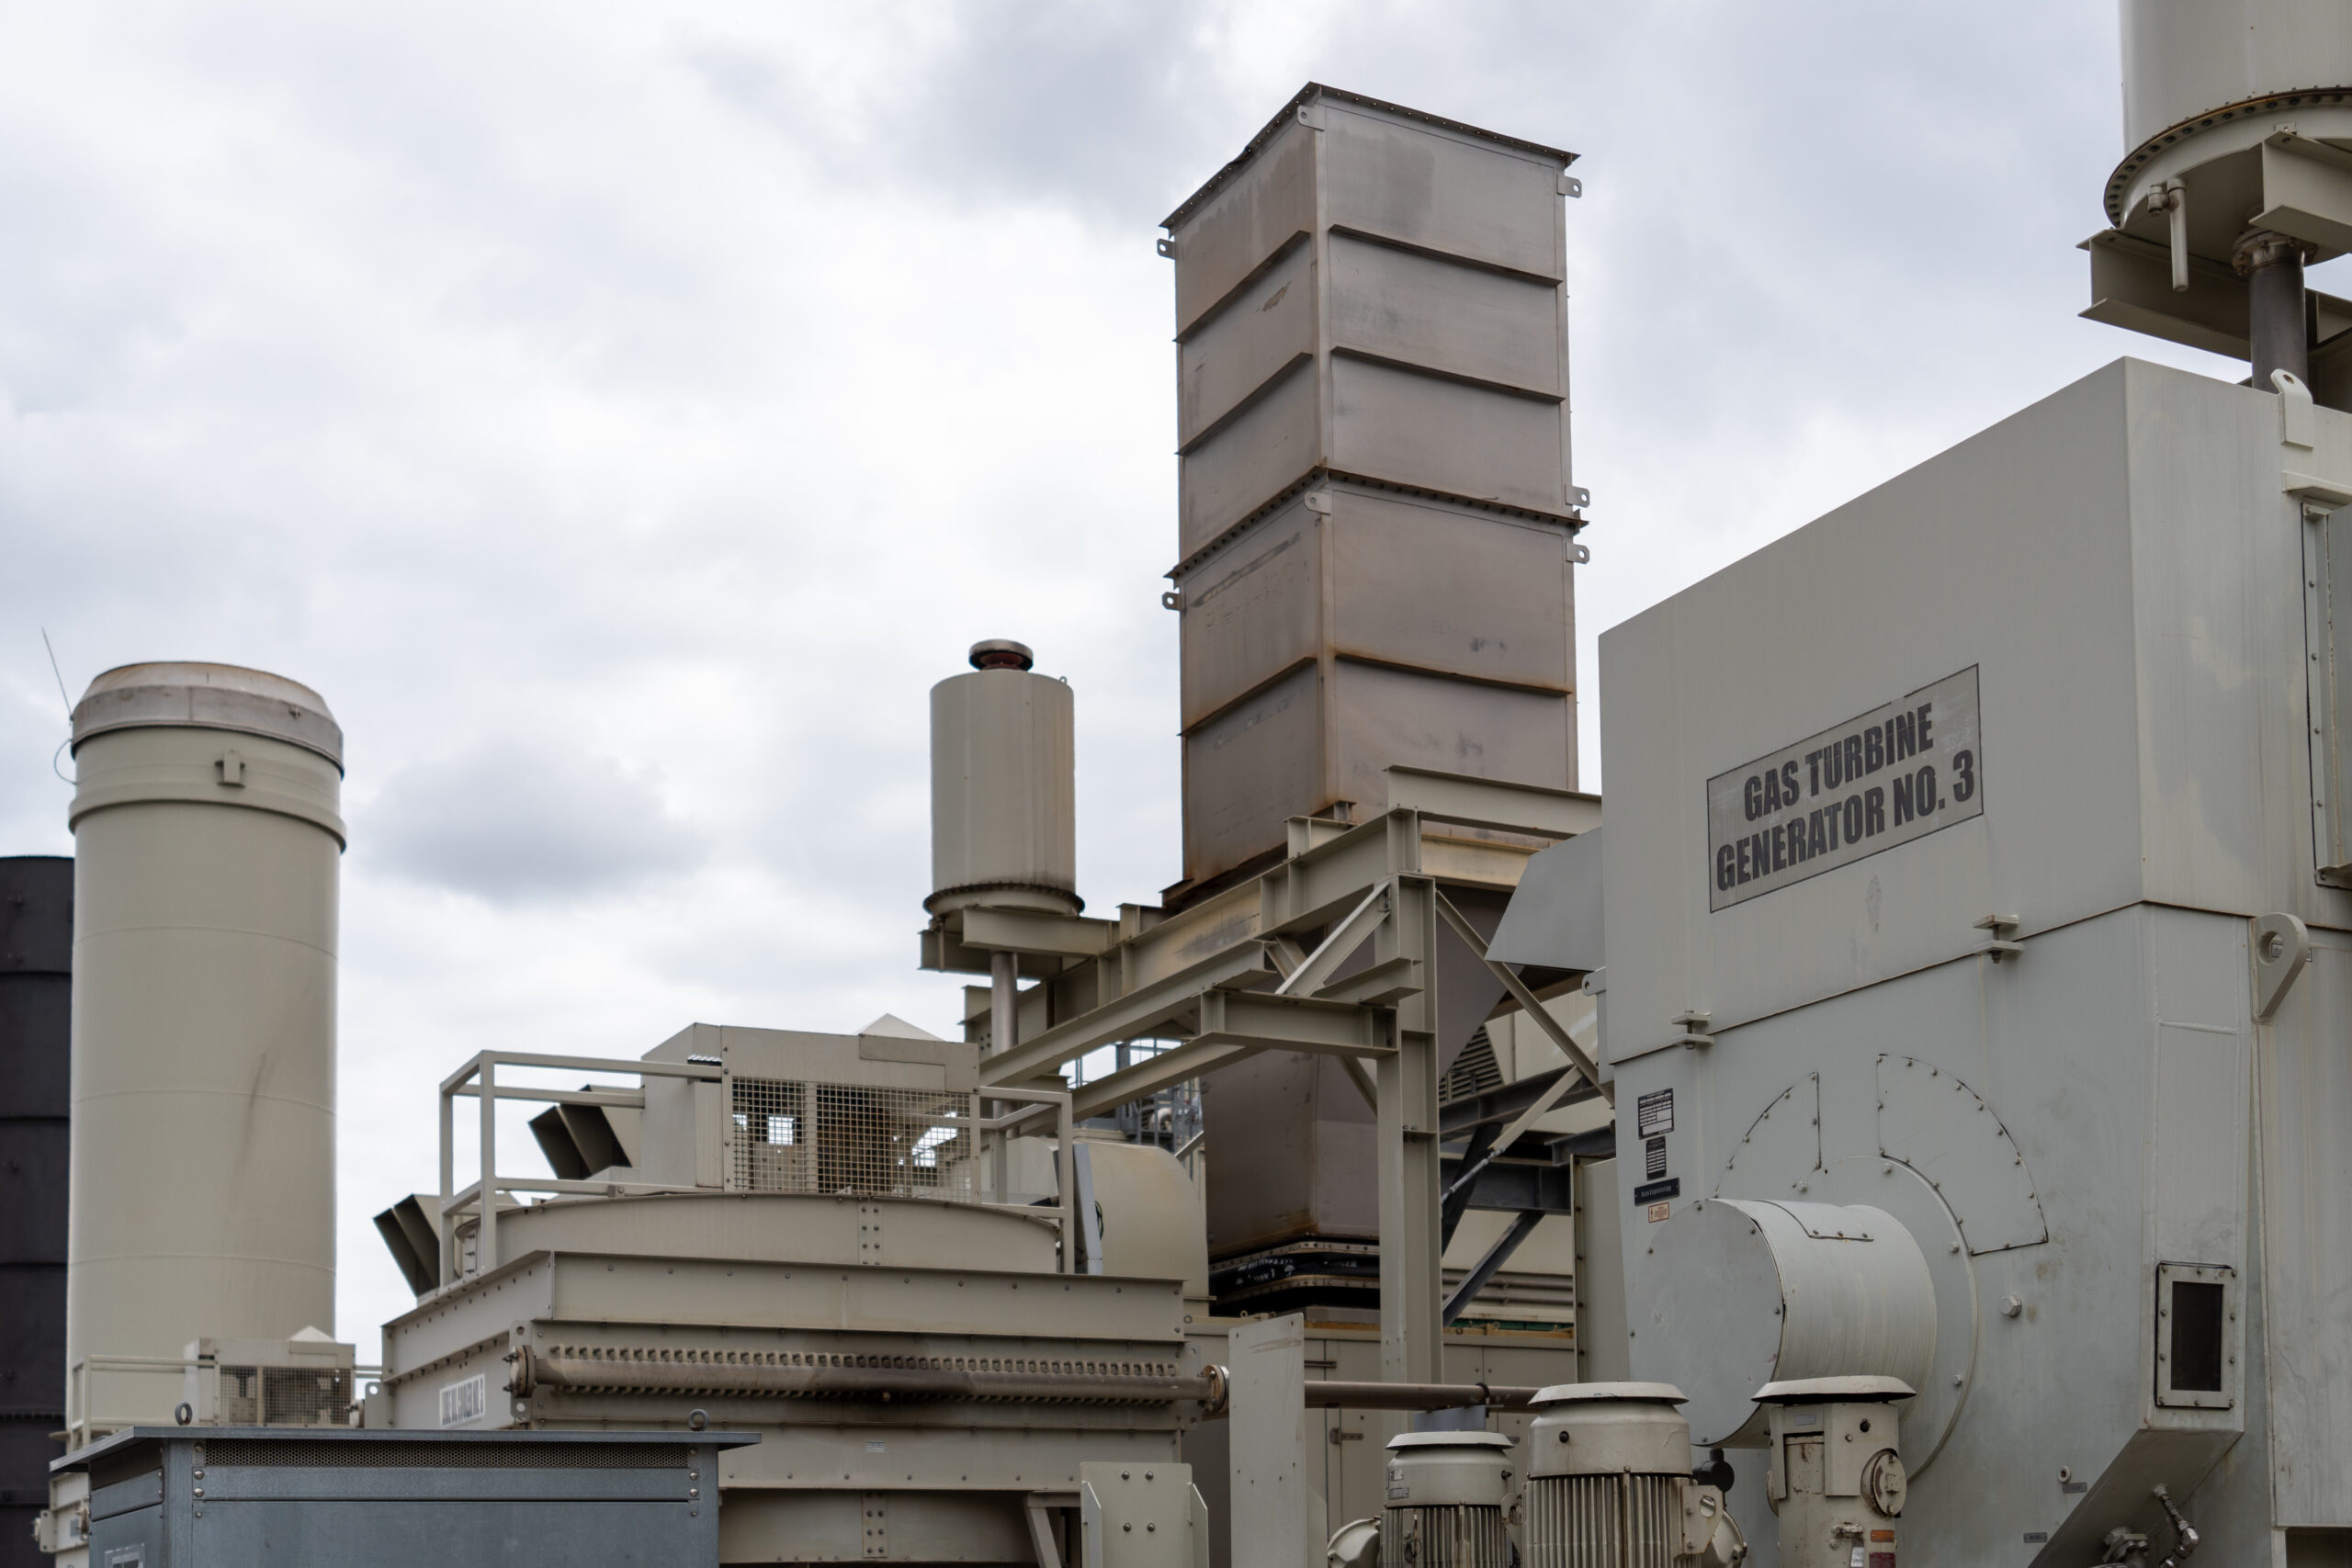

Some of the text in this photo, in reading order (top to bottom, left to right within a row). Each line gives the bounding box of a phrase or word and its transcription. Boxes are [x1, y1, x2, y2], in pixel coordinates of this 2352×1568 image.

[1716, 750, 1974, 891] GENERATOR NO. 3
[1744, 702, 1933, 821] GAS TURBINE
